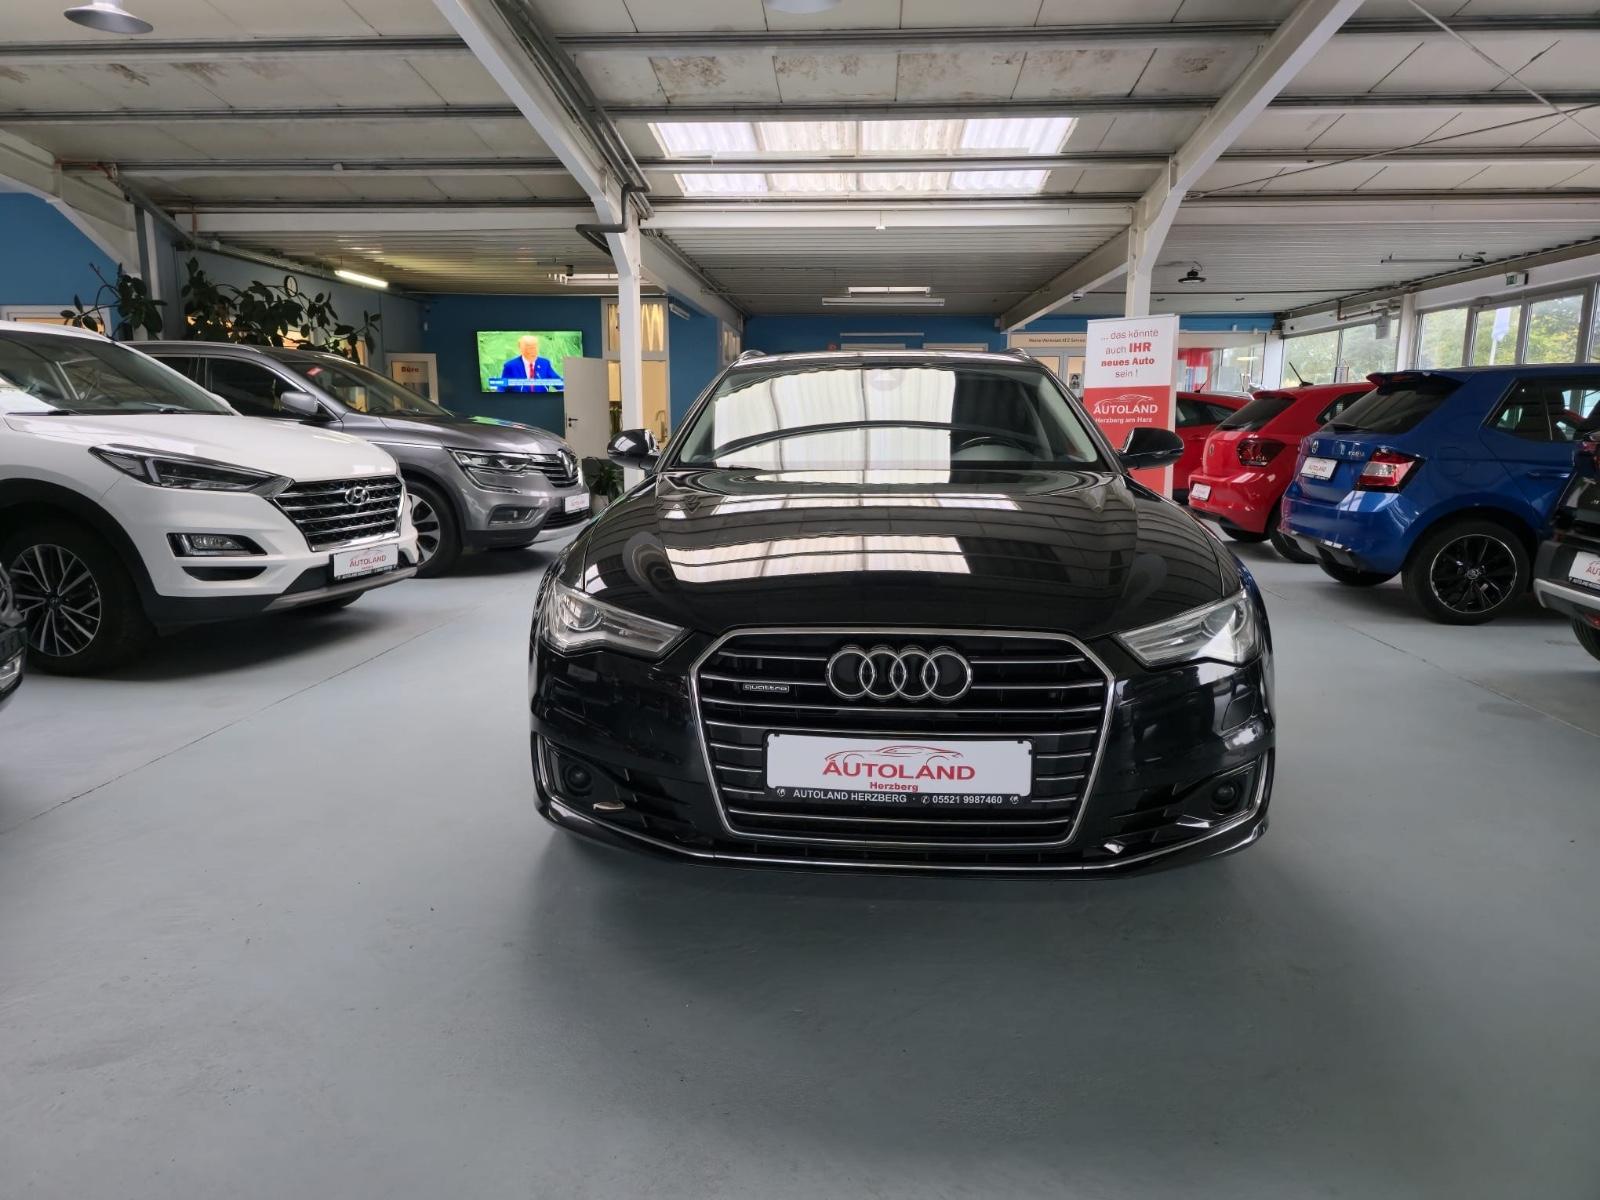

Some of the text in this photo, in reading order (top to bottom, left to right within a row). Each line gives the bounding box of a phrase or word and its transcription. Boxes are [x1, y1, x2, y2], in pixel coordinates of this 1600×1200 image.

[1128, 328, 1159, 338] könnte
[1105, 342, 1152, 355] auch IHR
[1101, 357, 1155, 367] neues Auto
[1115, 369, 1133, 378] sein
[1093, 404, 1158, 415] AUTOLAND
[349, 554, 387, 568] AUTOLAND
[822, 760, 976, 781] AUTOLAND
[869, 781, 919, 793] Herzberg
[793, 789, 1003, 804] AUTOLAND HERZBERG 05521 9987460
